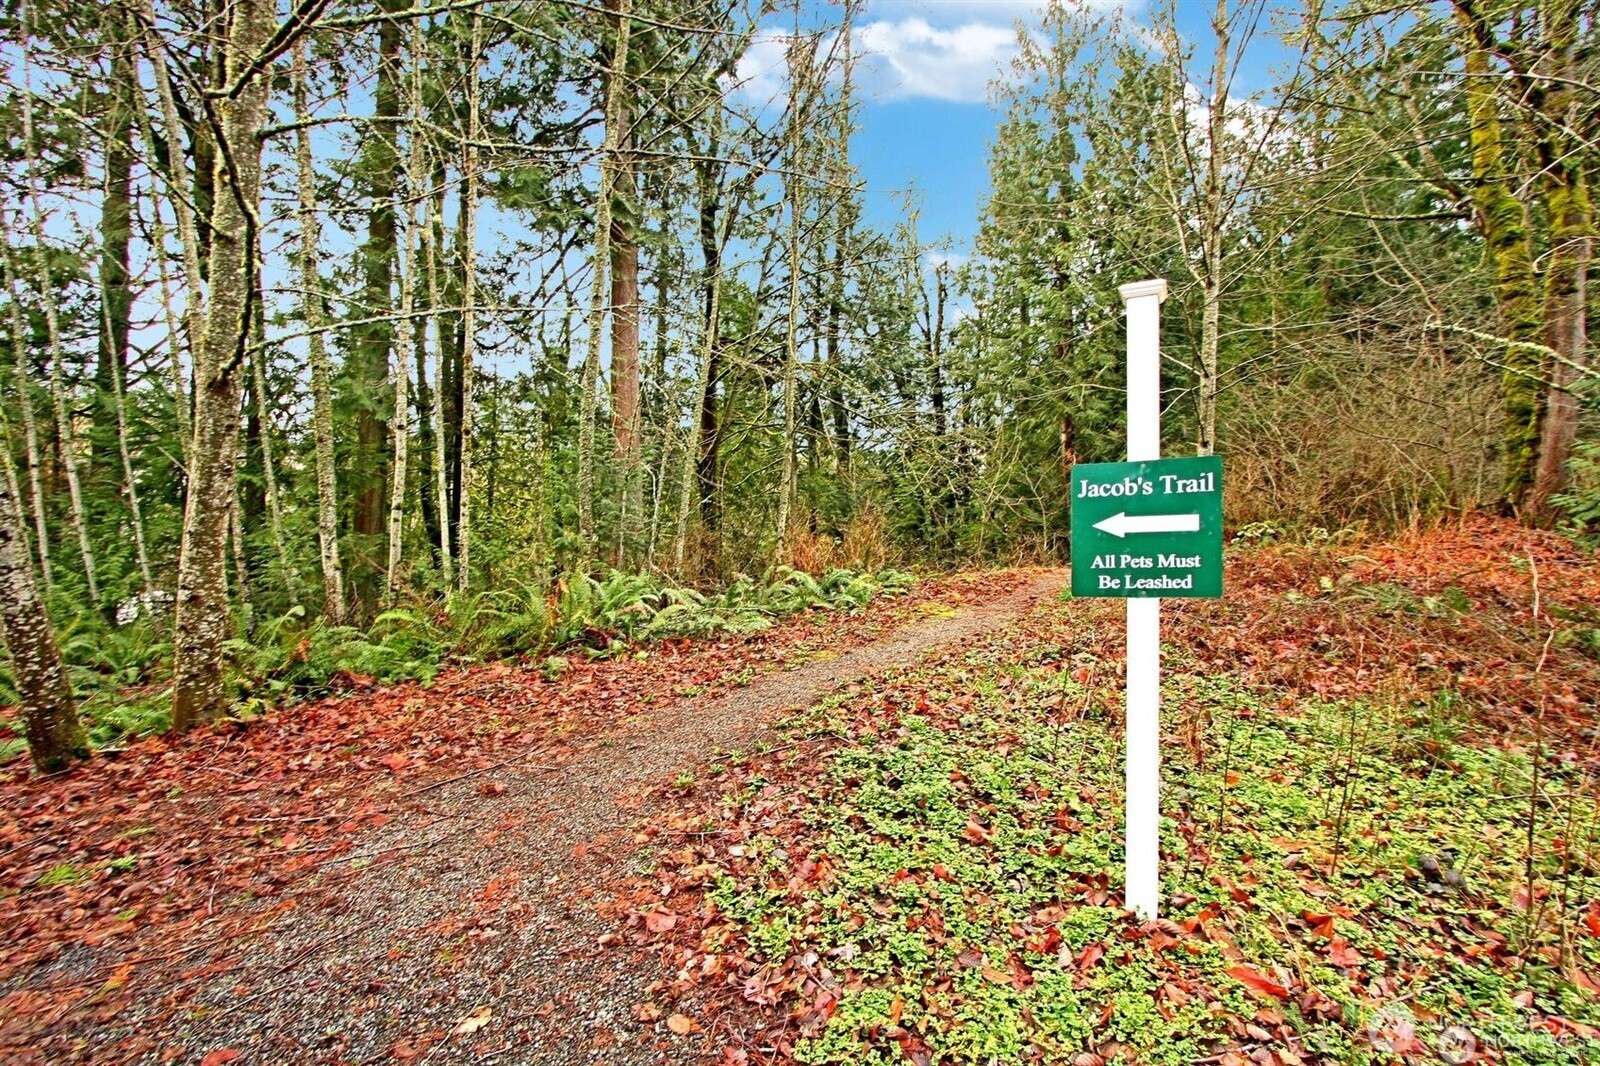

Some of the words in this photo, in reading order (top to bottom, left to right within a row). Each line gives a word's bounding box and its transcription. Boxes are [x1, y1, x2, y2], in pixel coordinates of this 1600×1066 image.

[1077, 477, 1154, 498] Jacob's
[1159, 472, 1215, 495] Trail
[1090, 554, 1116, 568] All
[1119, 554, 1153, 568] Pets
[1157, 554, 1201, 568] Must
[1098, 575, 1121, 589] Be
[1124, 574, 1193, 589] Leashed
